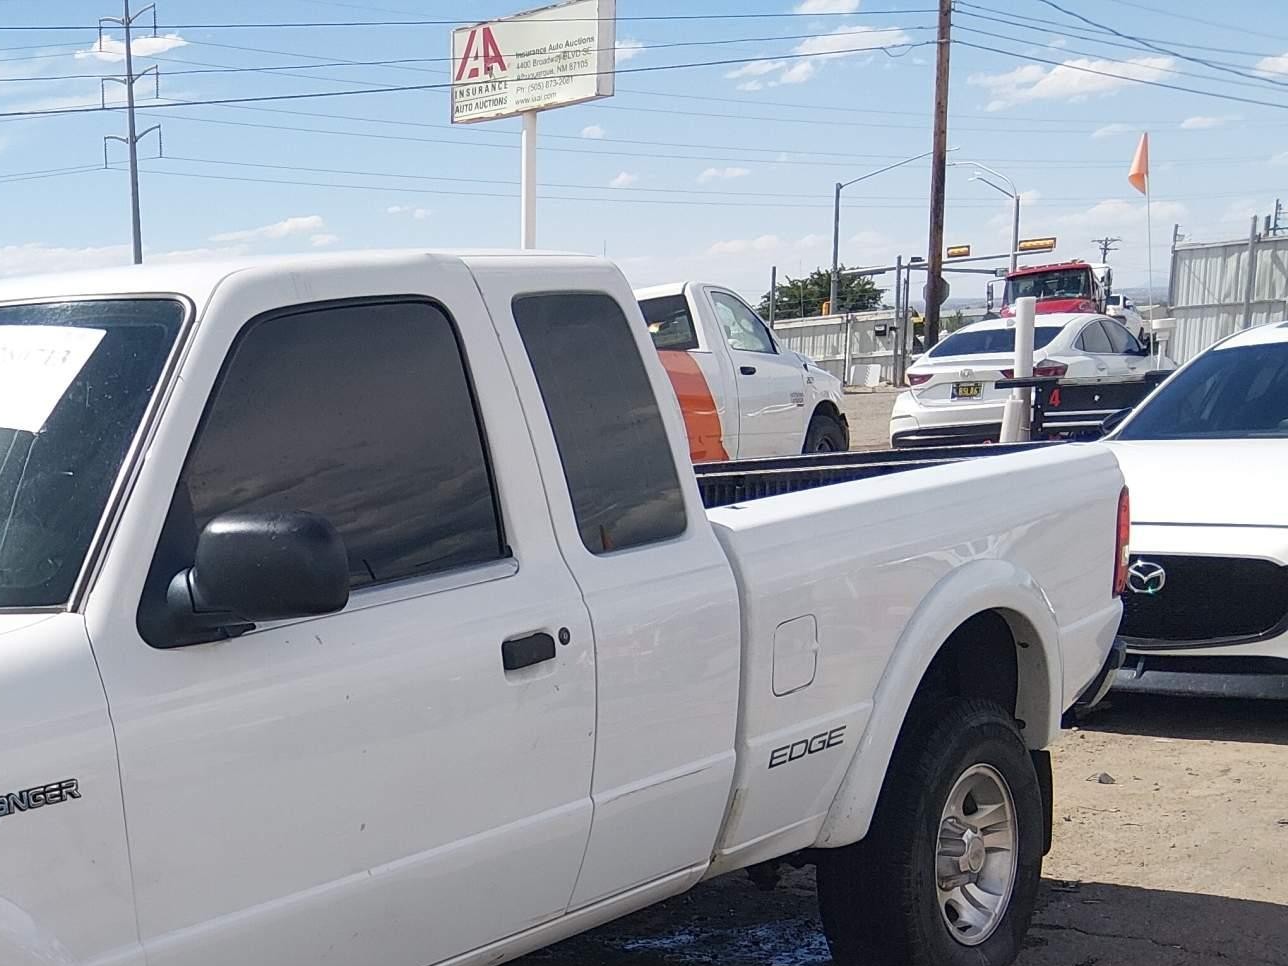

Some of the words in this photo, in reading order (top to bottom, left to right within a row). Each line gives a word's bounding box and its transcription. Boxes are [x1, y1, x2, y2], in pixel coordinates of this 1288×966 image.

[548, 43, 564, 52] Auto
[565, 36, 595, 49] Auctions
[533, 54, 561, 67] Broadway
[556, 64, 568, 73] NM
[455, 79, 509, 99] INSURANCE
[455, 102, 473, 114] AUTO
[474, 96, 508, 111] AUCTIONS
[1049, 388, 1062, 407] 4
[767, 725, 847, 769] EDGE
